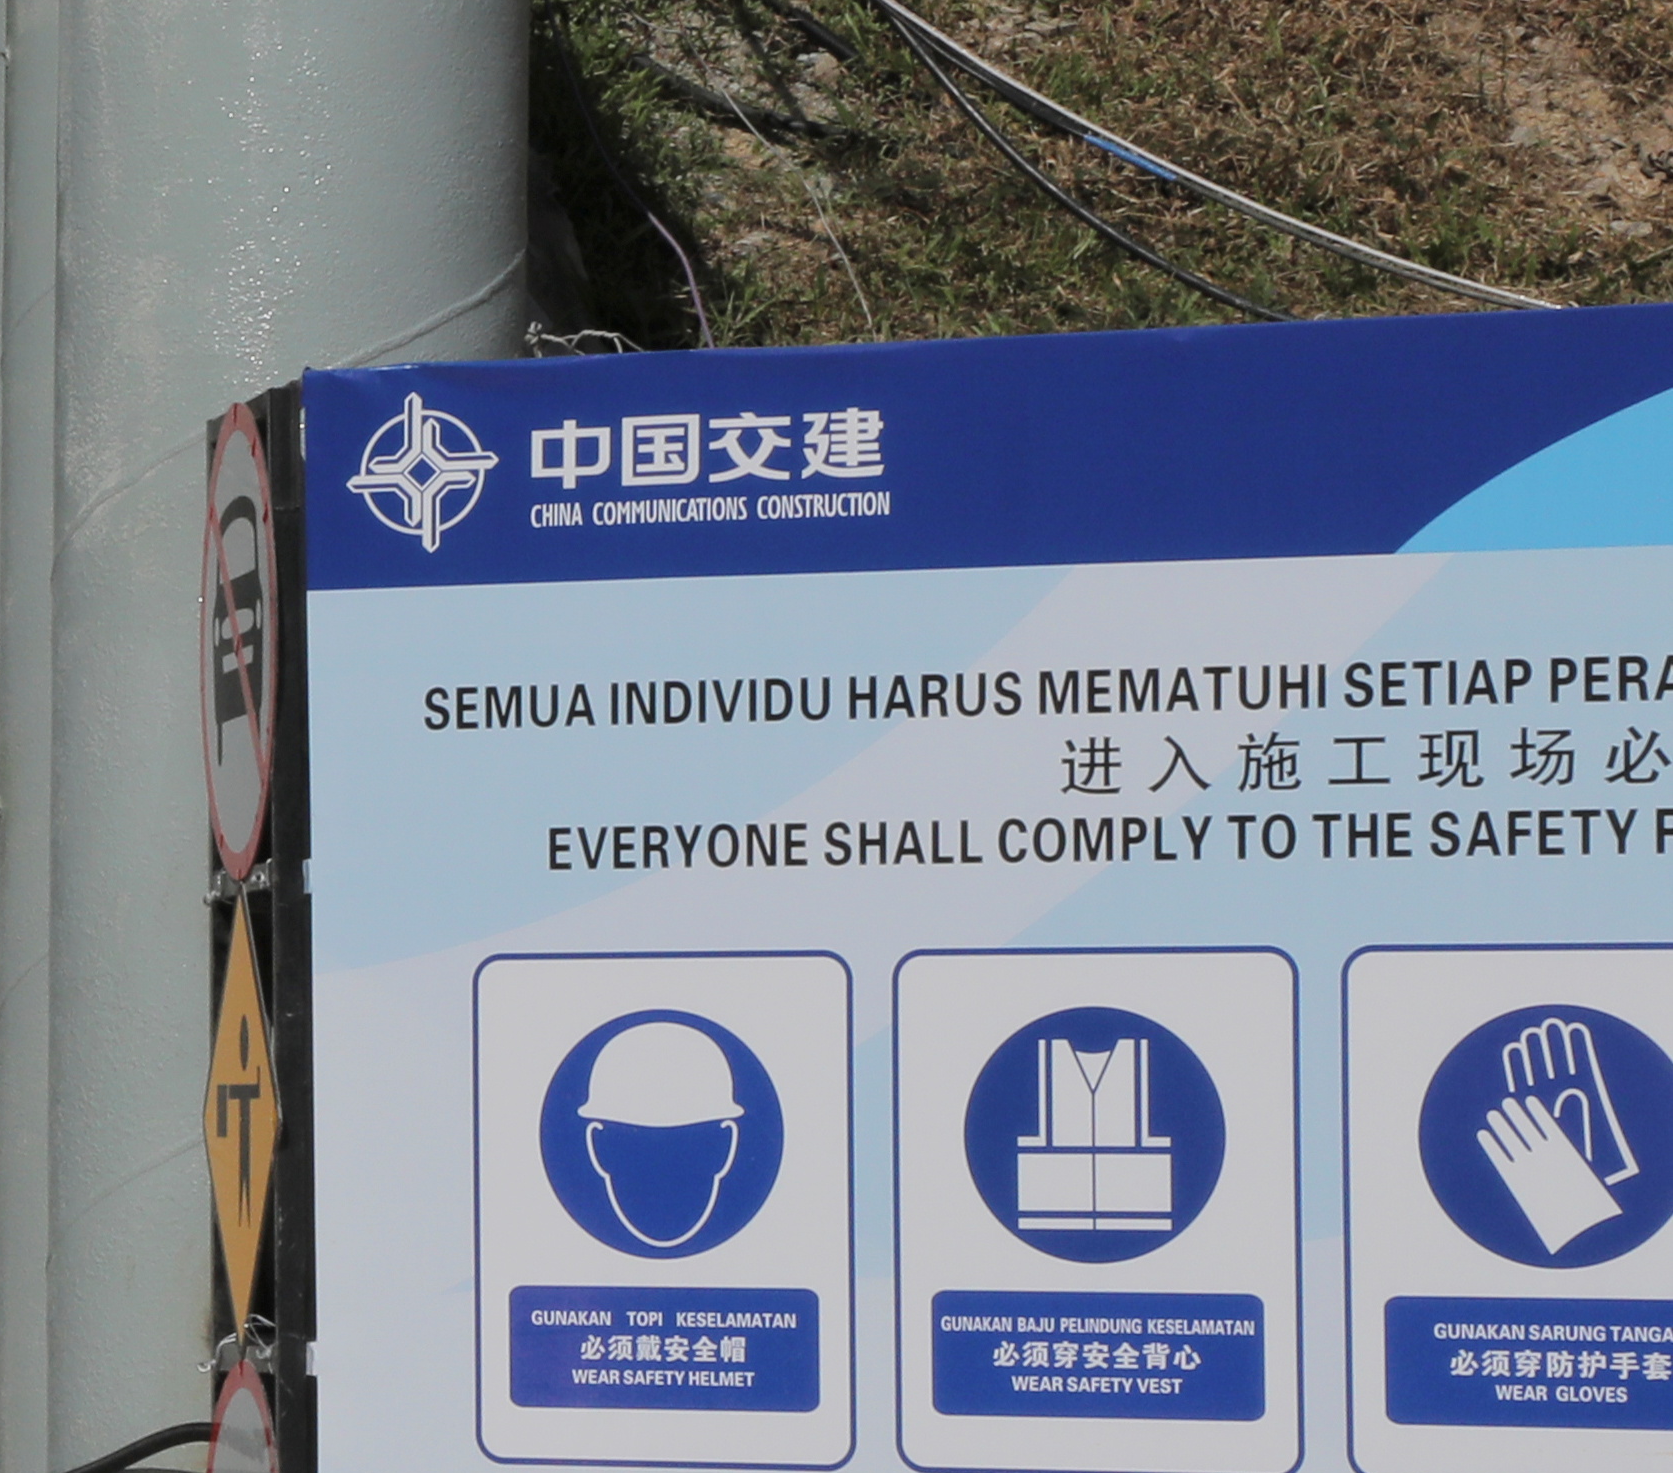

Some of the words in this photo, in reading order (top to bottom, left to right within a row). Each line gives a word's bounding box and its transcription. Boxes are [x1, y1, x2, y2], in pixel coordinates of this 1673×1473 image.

[531, 407, 884, 489] 中国交建
[530, 501, 583, 528] CHINA
[592, 496, 747, 525] COMMUNICATIONS
[756, 492, 890, 520] CONSTRUCTION
[425, 684, 595, 730] SEMUA
[611, 678, 829, 724] INDIVIDU
[850, 672, 1021, 719] HARUS
[1040, 664, 1325, 714] MEMATUHI
[1345, 659, 1531, 707] SETIAP
[1062, 727, 1671, 794] 进入施工现场必
[550, 824, 807, 869] EVERYONE
[825, 821, 982, 865] SHALL
[999, 816, 1211, 862] COMPLY
[1228, 814, 1296, 859] TO
[1313, 813, 1411, 858] THE
[1431, 809, 1637, 856] SAFETY
[531, 1310, 611, 1326] GUNAKAN
[626, 1311, 662, 1326] TOPI
[676, 1312, 796, 1328] KESELAMATAN
[941, 1316, 1012, 1332] GUNAKAN
[1018, 1317, 1054, 1332] BAJU
[1060, 1318, 1142, 1334] PELINDUNG
[1148, 1319, 1254, 1335] KESELAMATAN
[1433, 1323, 1525, 1340] GUNAKAN
[1529, 1324, 1606, 1341] SARUNG
[581, 1335, 745, 1362] 必须戴安全帽
[993, 1341, 1201, 1370] 必须穿安全背心
[572, 1369, 620, 1384] WEAR
[623, 1370, 685, 1385] SAFETY
[689, 1371, 755, 1386] HELMET
[1449, 1349, 1672, 1381] 必须穿防护手套
[1012, 1376, 1063, 1391] WEAR
[1067, 1377, 1133, 1393] SAFETY
[1137, 1378, 1182, 1394] VEST
[1495, 1384, 1548, 1401] WEAR
[1556, 1386, 1628, 1403] GLOVES
